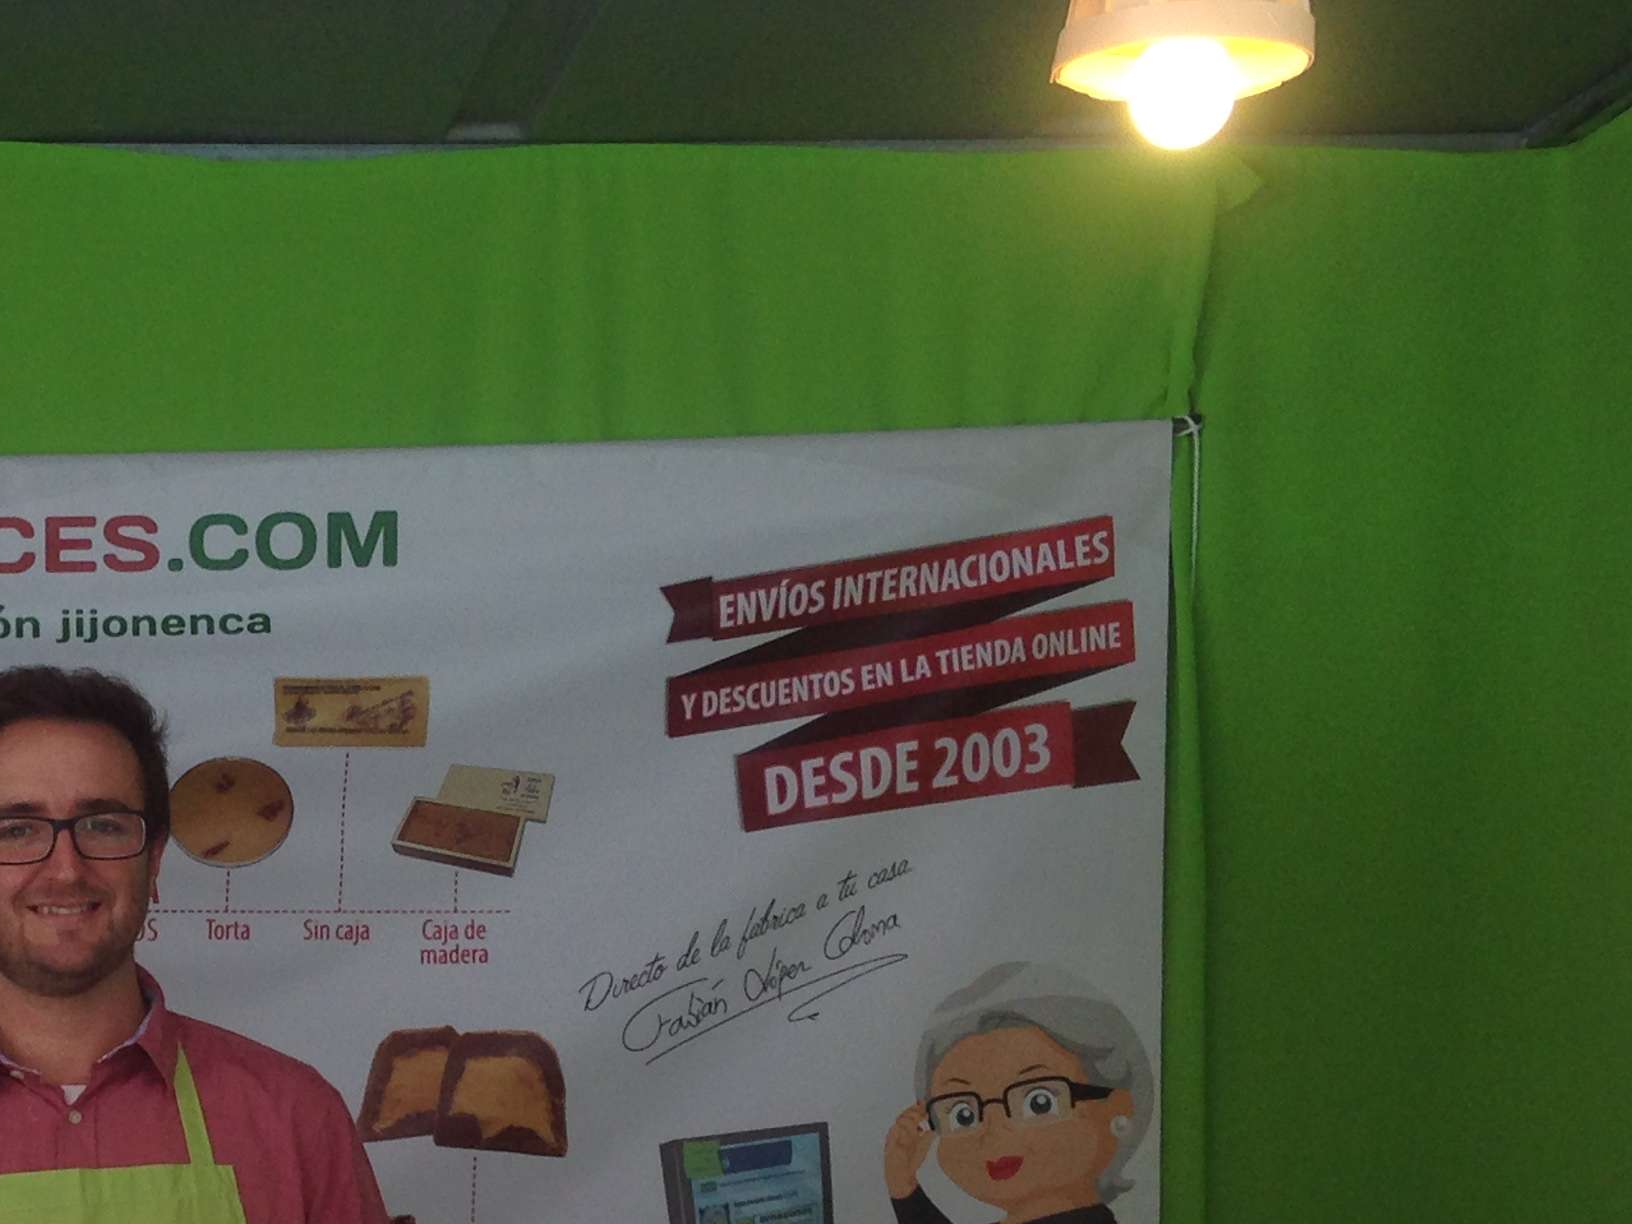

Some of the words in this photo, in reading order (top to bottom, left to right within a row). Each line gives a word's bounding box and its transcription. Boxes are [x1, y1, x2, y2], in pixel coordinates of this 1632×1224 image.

[719, 577, 825, 629] ENVÍOS
[833, 531, 1110, 608] INTERNACIONALES
[57, 607, 272, 643] jijonenca
[681, 692, 699, 721] Y
[702, 668, 854, 715] DESCUENTOS
[861, 662, 893, 692] EN
[899, 655, 931, 686] LA
[936, 635, 1026, 677] TIENDA
[1032, 622, 1121, 661] ONLINE
[764, 741, 918, 815] DESDE
[932, 723, 1051, 789] 2003
[206, 919, 250, 942] Torta
[303, 919, 329, 942] Sin
[334, 920, 370, 947] caja
[421, 920, 459, 945] Caja
[463, 919, 486, 941] de
[579, 954, 669, 1012] Directo
[676, 931, 701, 971] de
[710, 919, 732, 957] la
[816, 894, 829, 910] a
[838, 871, 858, 902] tu
[867, 858, 912, 888] casa
[420, 944, 488, 965] madera
